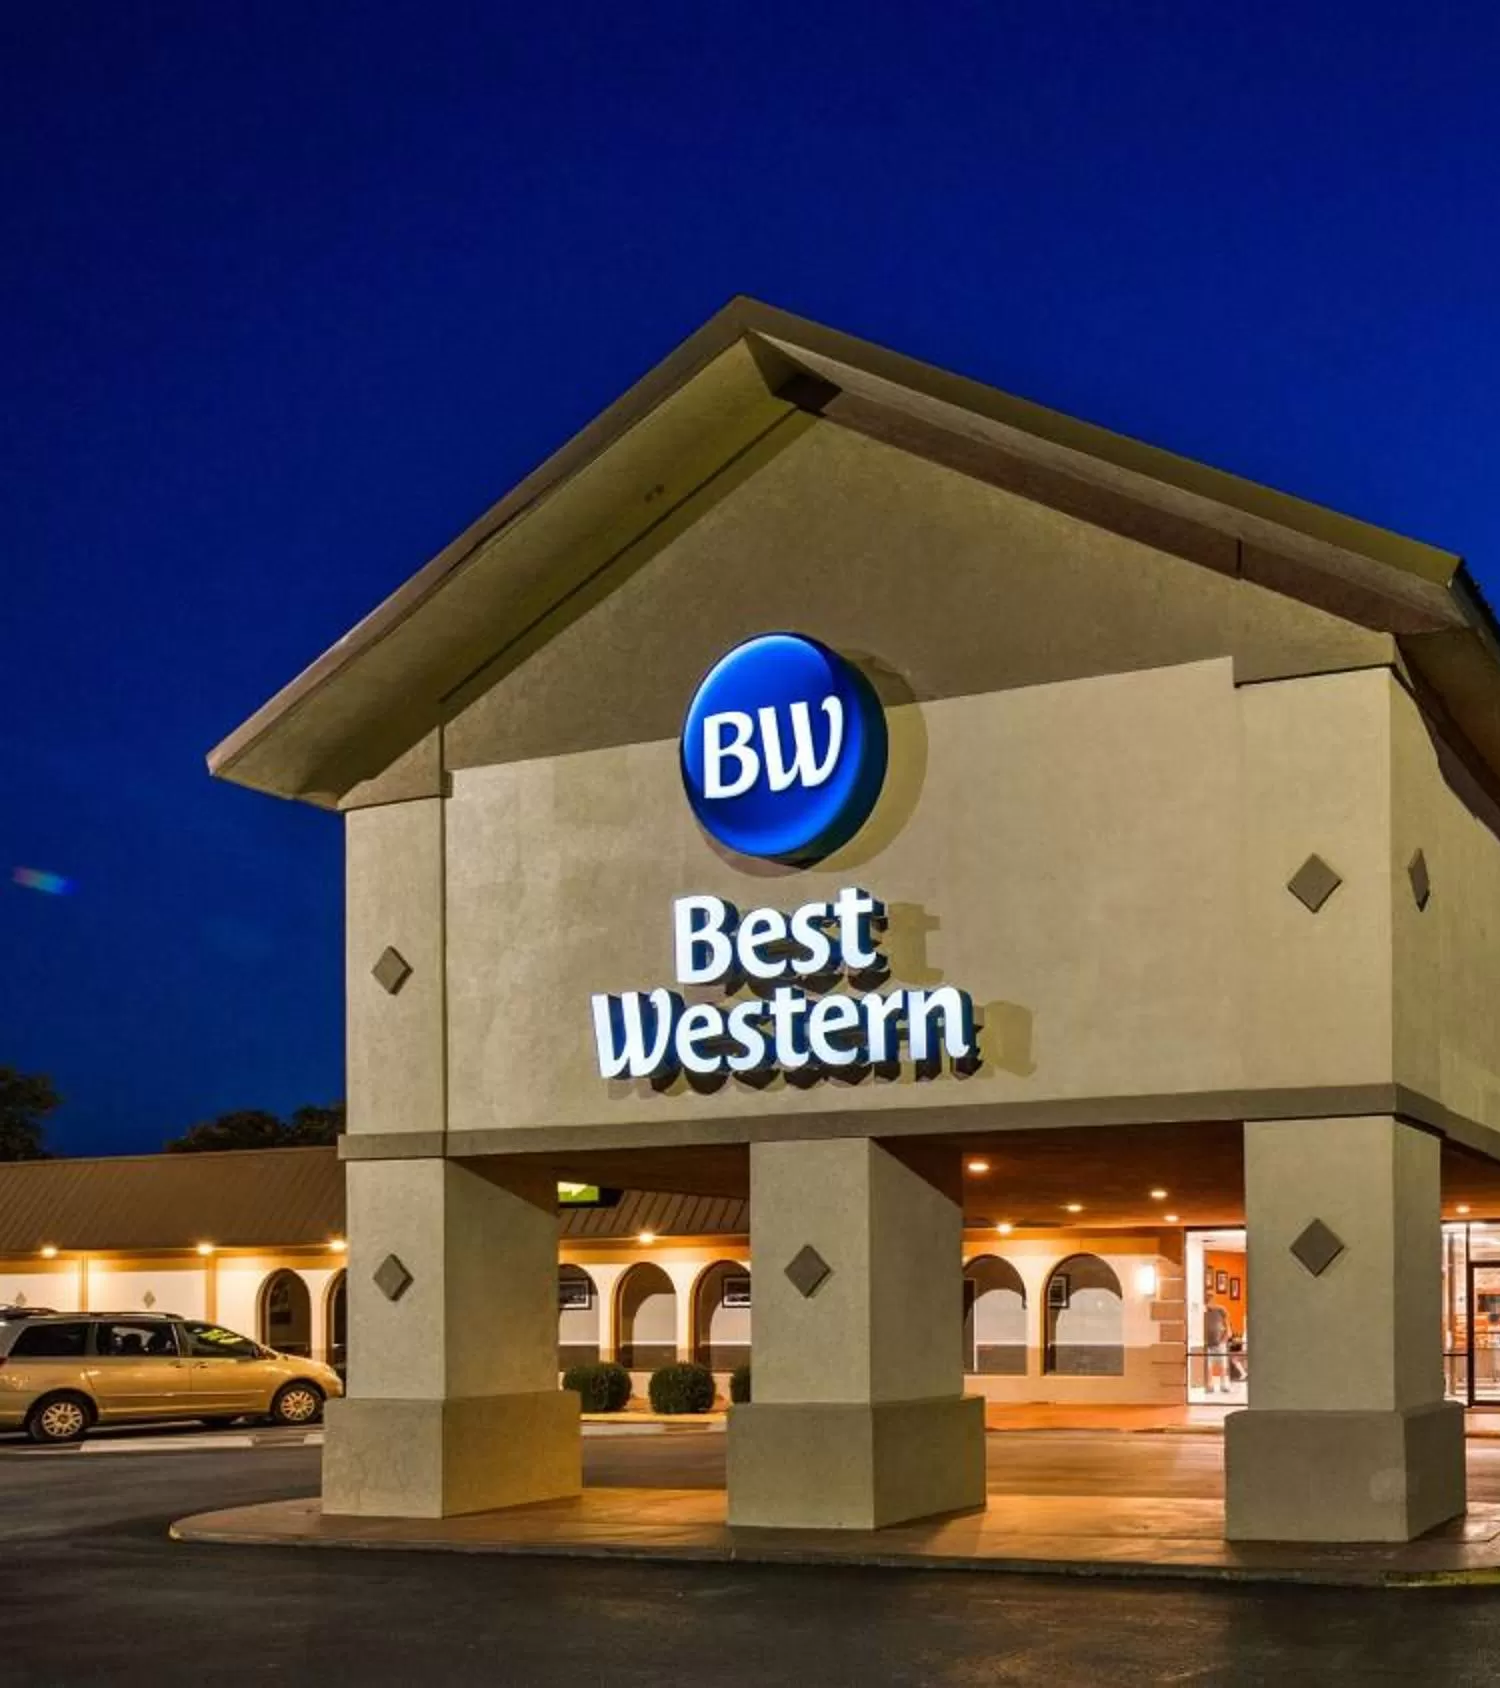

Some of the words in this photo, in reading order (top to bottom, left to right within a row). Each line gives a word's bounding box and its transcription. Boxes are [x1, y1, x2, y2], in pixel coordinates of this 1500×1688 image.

[703, 696, 843, 798] BW
[673, 887, 877, 985] Best
[591, 986, 970, 1079] Western
